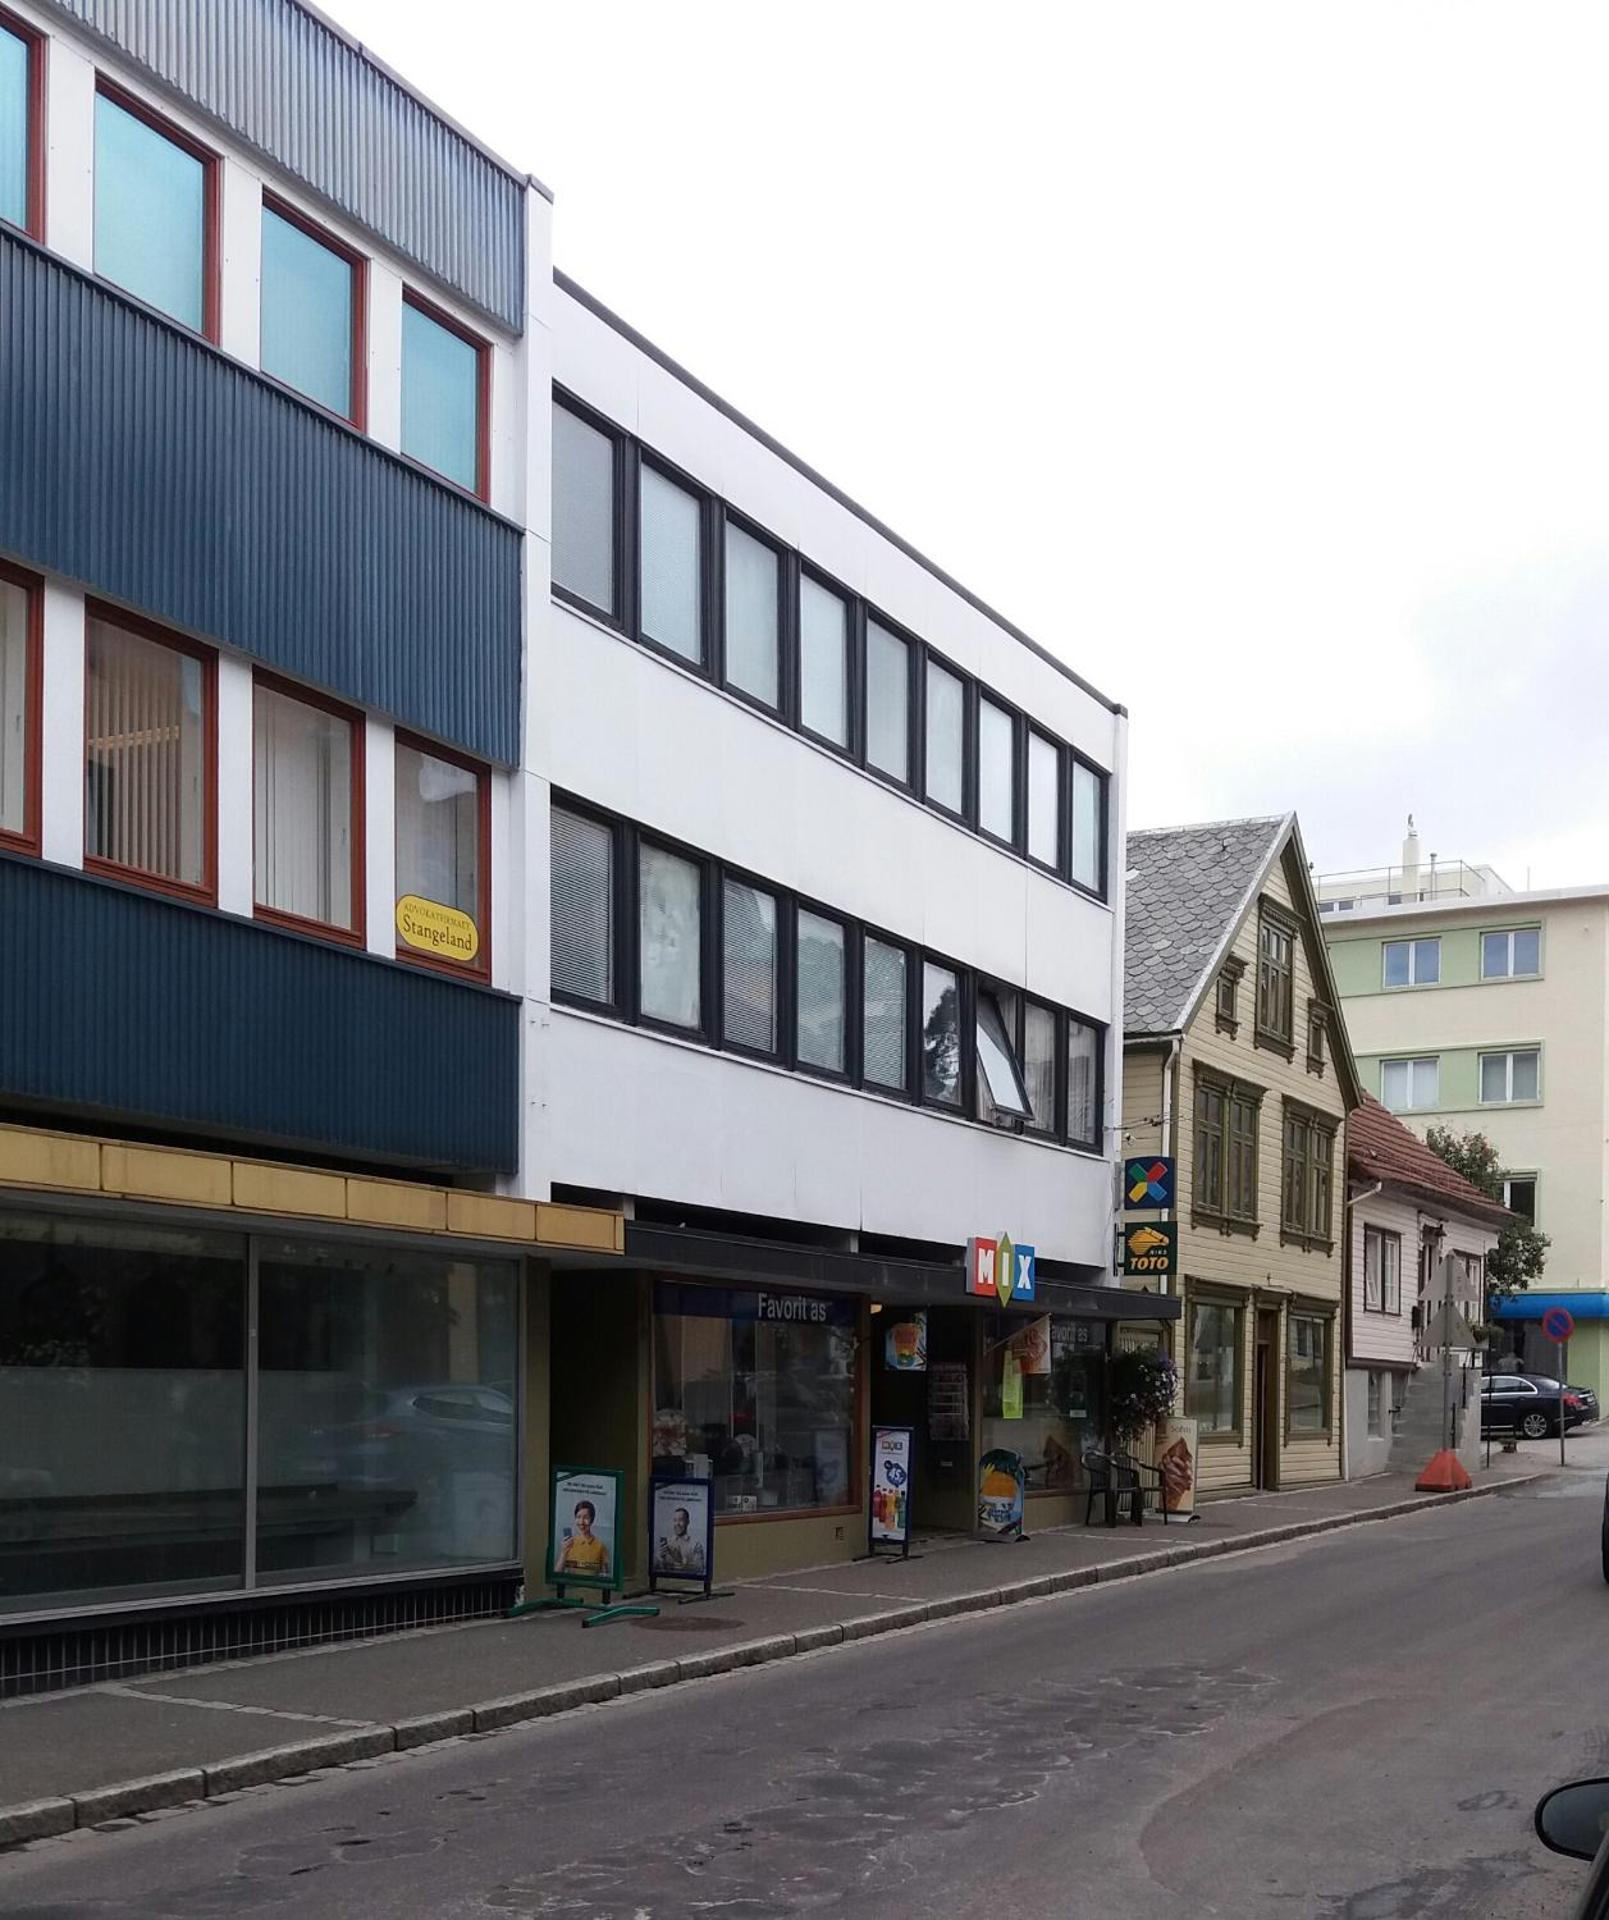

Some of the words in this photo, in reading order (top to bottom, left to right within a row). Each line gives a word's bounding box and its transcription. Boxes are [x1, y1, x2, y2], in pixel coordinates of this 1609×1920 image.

[403, 913, 472, 951] Stangeland
[978, 1247, 1033, 1290] MIX
[1130, 1256, 1169, 1270] TOTO
[758, 1292, 808, 1321] Favorit
[811, 1302, 826, 1322] as
